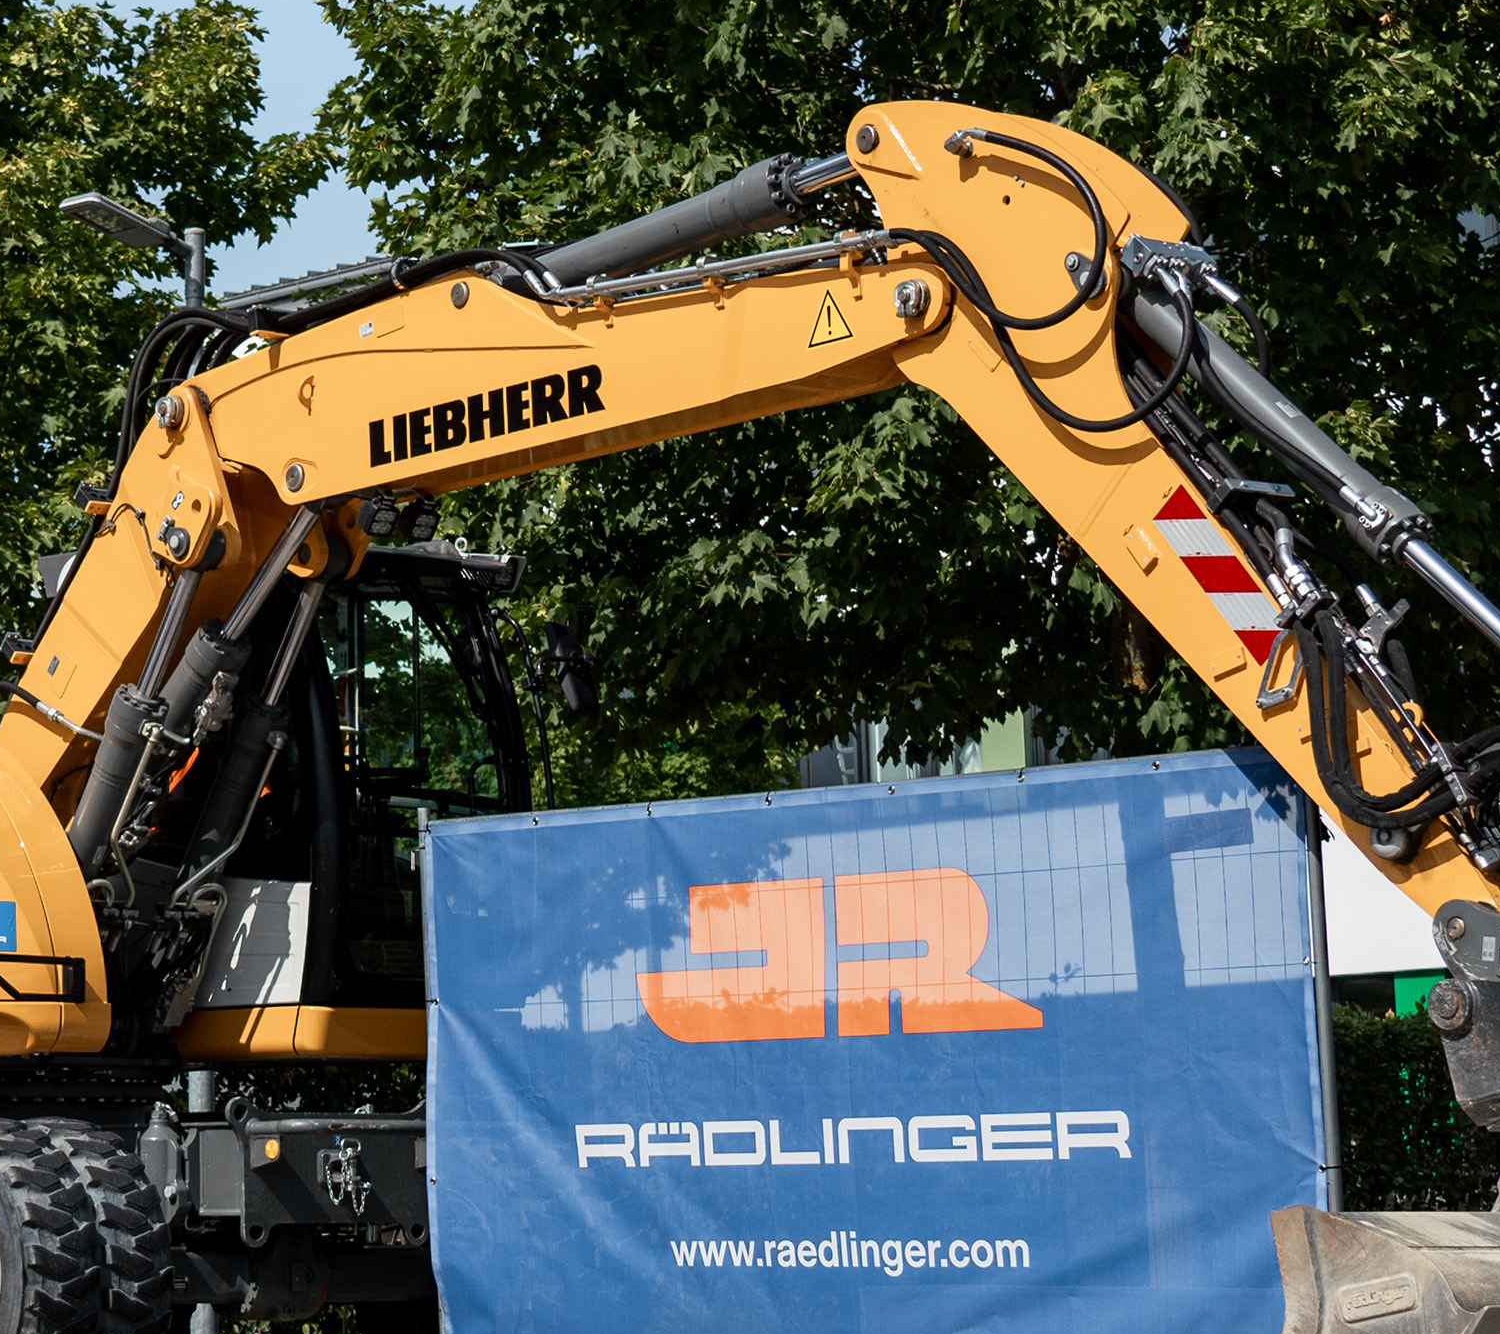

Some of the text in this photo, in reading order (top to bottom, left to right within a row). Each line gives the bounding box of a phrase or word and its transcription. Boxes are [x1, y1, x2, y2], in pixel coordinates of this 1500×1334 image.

[369, 364, 606, 468] LIEBHERR
[575, 1109, 1133, 1169] RÄDLINGER
[669, 1230, 1031, 1278] www.raedlinger.com
